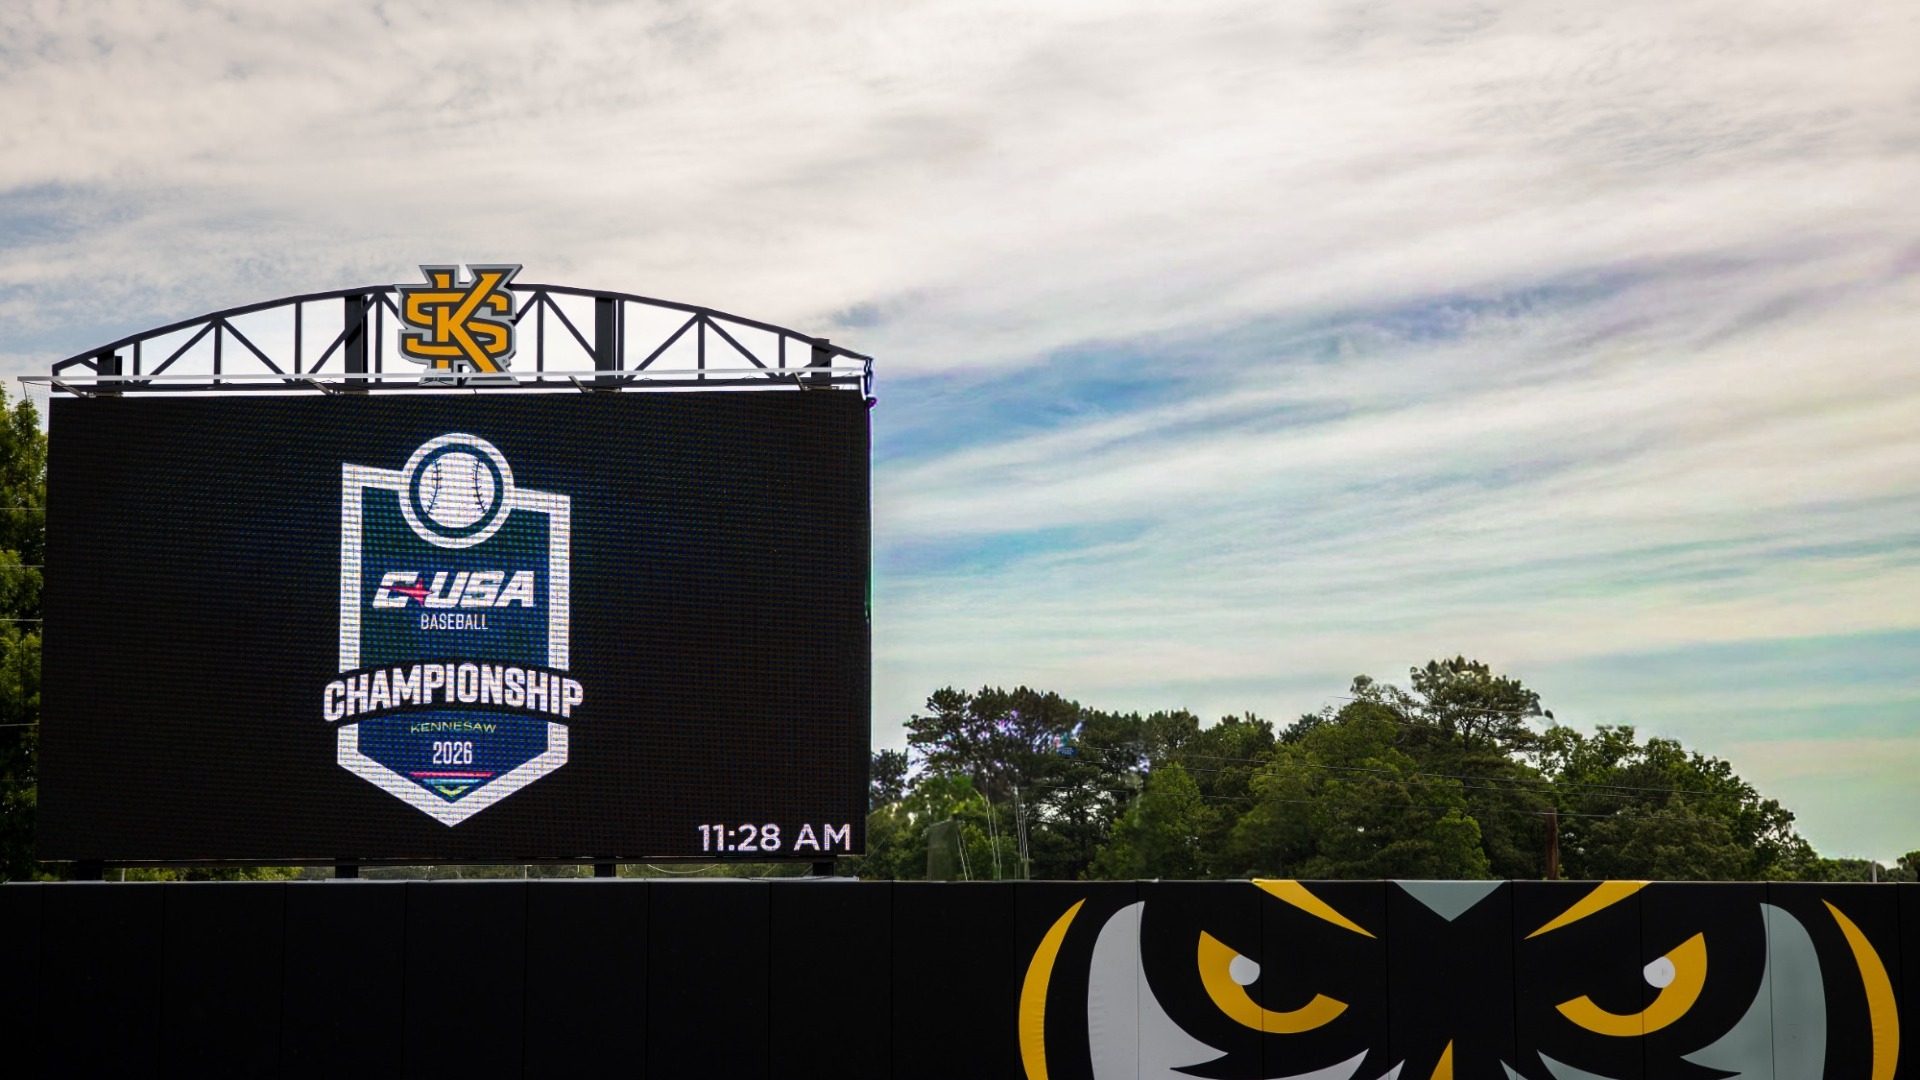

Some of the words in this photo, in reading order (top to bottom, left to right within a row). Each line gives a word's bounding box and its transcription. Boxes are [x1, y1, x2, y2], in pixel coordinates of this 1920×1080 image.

[420, 613, 489, 630] BASEBALL
[323, 662, 584, 722] CHAMPIONSHIP
[410, 721, 497, 734] KENNESAW
[432, 741, 473, 765] 2026
[698, 823, 782, 852] 11:28
[793, 823, 851, 851] AM
